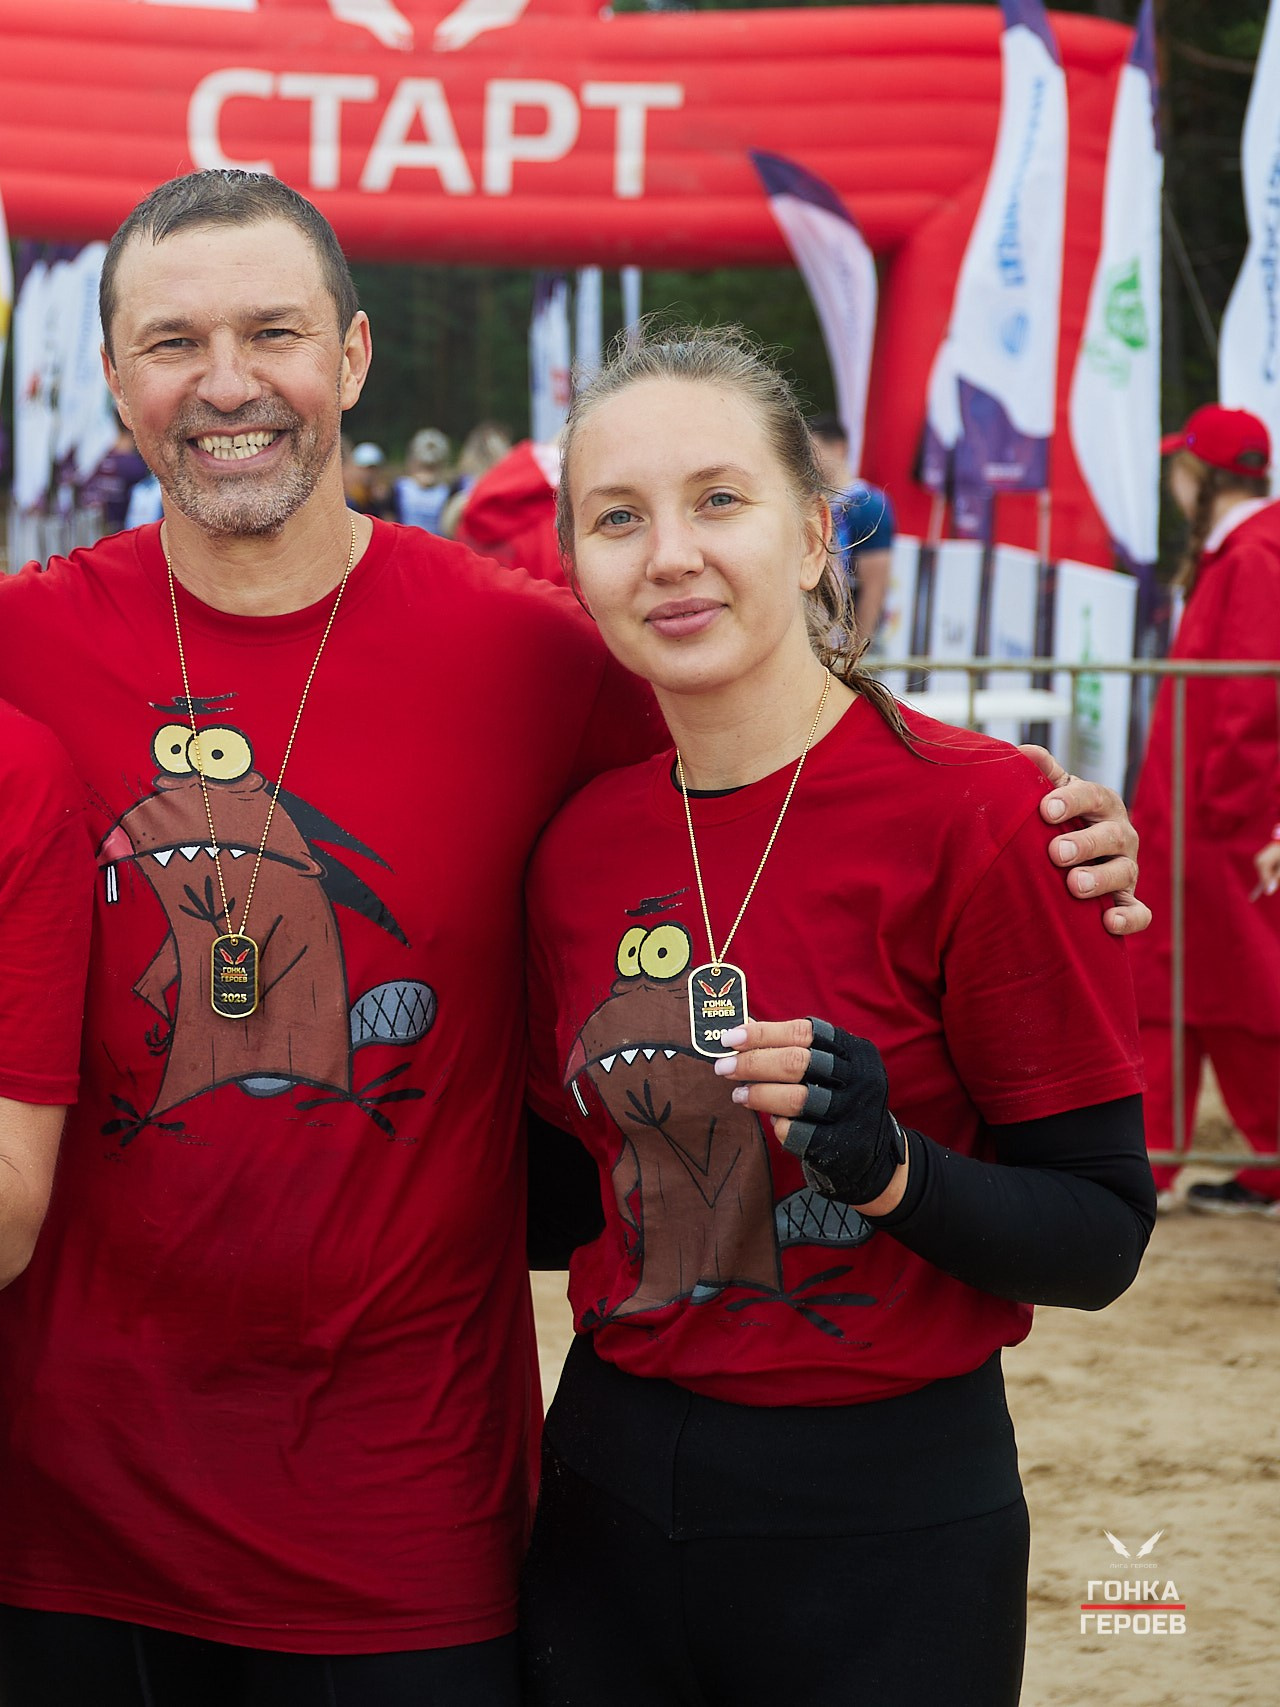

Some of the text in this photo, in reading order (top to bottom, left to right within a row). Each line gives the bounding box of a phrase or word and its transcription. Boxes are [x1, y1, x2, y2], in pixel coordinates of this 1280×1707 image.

[186, 68, 684, 199] СТАРТ
[222, 966, 246, 974] ГОНКА
[221, 993, 247, 1003] 2025
[703, 999, 732, 1008] ГОНКА
[702, 1009, 736, 1018] ГЕРОЕВ
